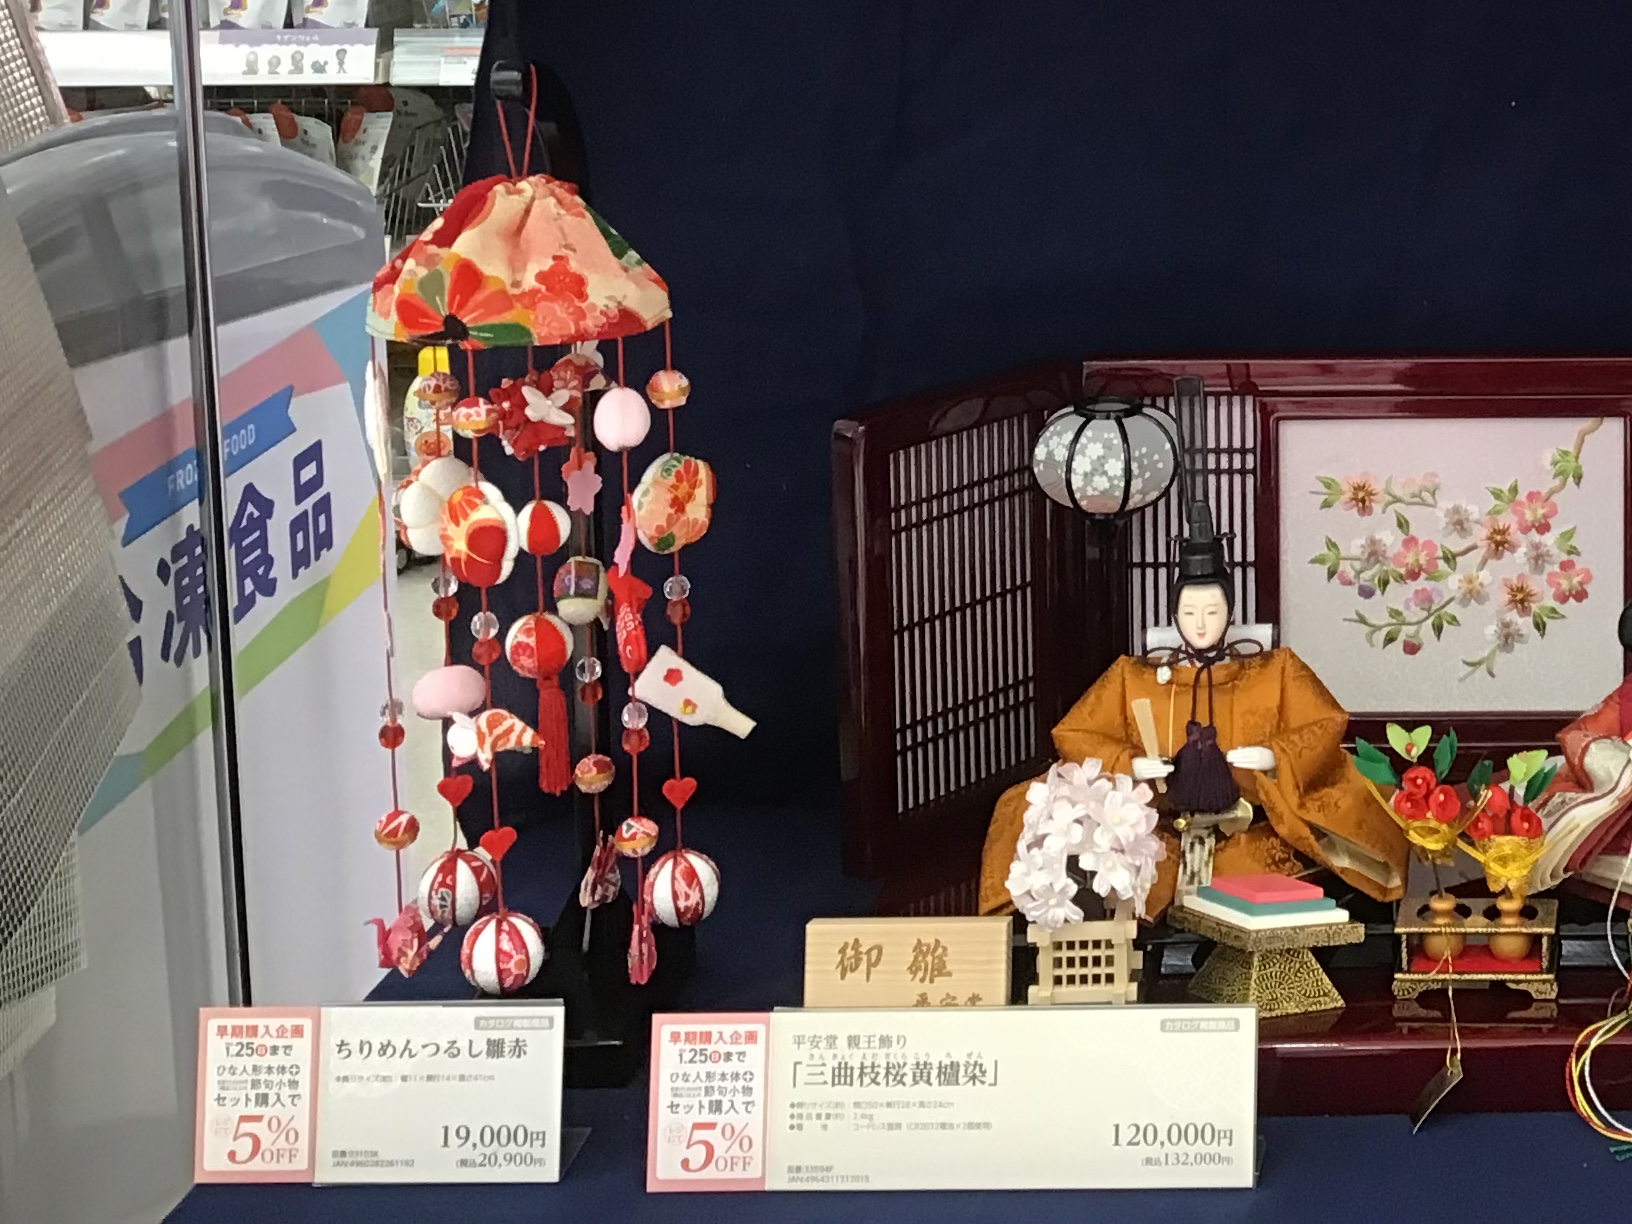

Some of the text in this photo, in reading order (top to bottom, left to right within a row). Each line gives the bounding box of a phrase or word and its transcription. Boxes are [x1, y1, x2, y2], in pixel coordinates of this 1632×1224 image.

[222, 423, 256, 462] FOOD
[118, 439, 334, 687] 凍食品
[216, 1024, 304, 1039] 早期購入企画
[668, 1030, 759, 1046] 早期購入企画
[335, 1037, 528, 1061] ちりめんつるし雛赤
[791, 1033, 908, 1051] 平安堂 親王飾り
[216, 1063, 290, 1077] ひな人形本体
[669, 1070, 742, 1084] ひな人形本体
[792, 1059, 999, 1088] 「三曲枝桜黄櫨染」
[250, 1078, 299, 1091] 節句小物
[703, 1085, 754, 1098] 節句小物
[213, 1092, 302, 1109] セット購入で
[666, 1099, 757, 1116] セット購入で
[227, 1114, 299, 1165] 5%
[440, 1124, 546, 1151] 19,000円
[1112, 1122, 1234, 1150] 120,000円
[260, 1147, 300, 1164] OFF
[680, 1120, 754, 1173] 5%
[714, 1155, 755, 1173] OFF
